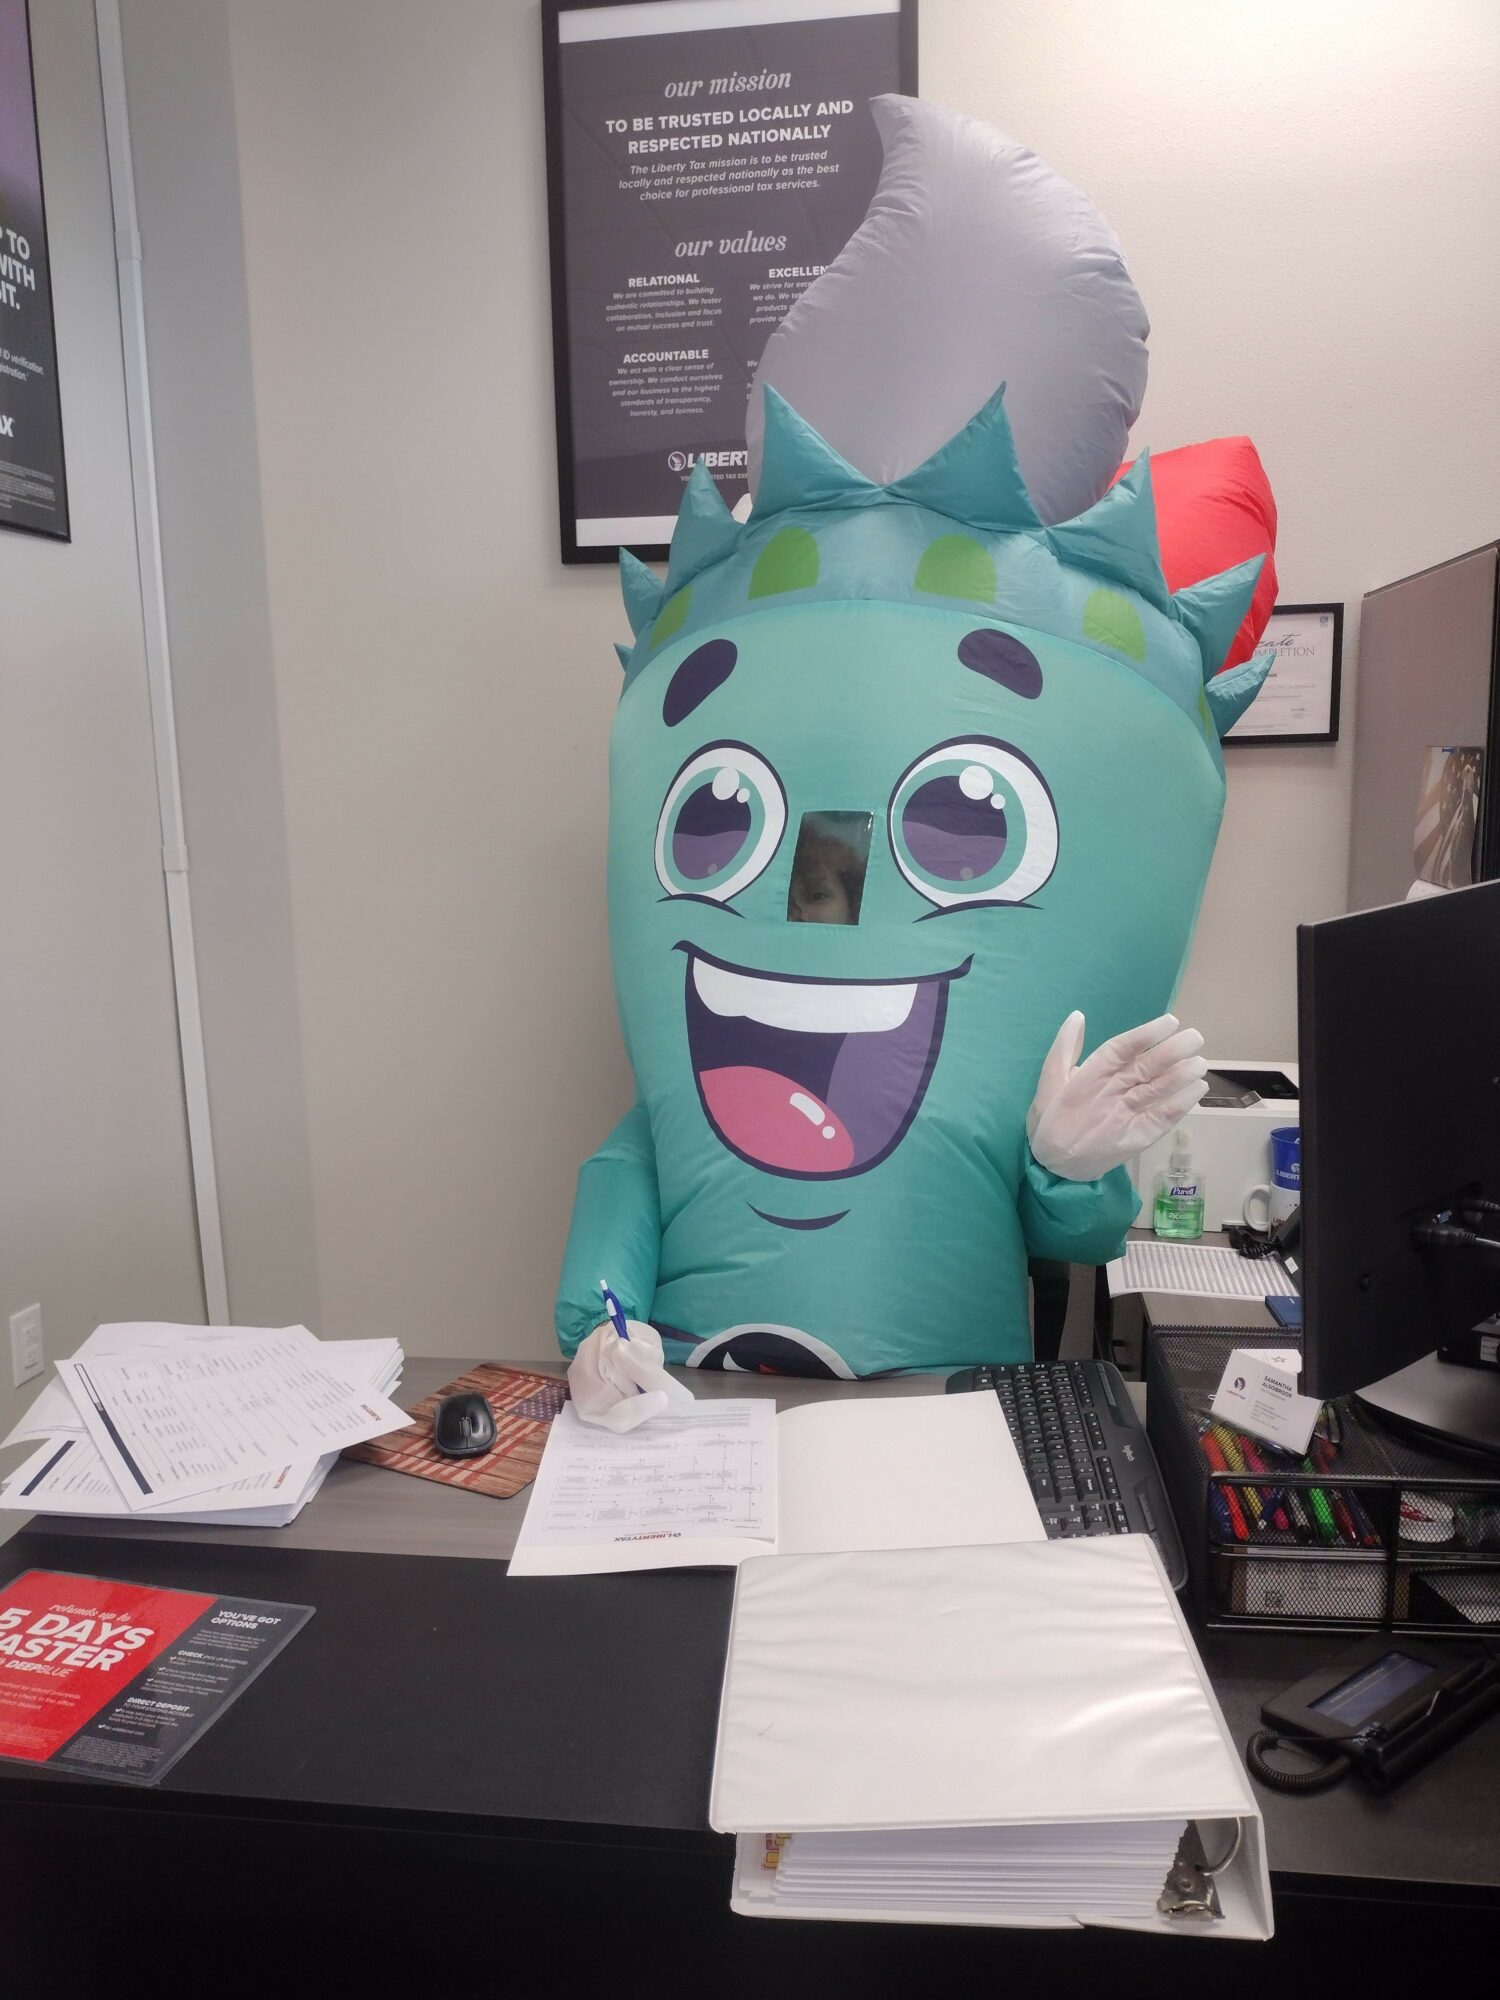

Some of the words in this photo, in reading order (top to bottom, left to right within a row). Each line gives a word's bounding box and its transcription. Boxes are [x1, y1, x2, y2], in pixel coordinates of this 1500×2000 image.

[664, 79, 704, 98] our
[708, 68, 792, 95] mission
[606, 119, 627, 133] TO
[633, 117, 653, 132] BE
[658, 110, 734, 130] TRUSTED
[739, 103, 811, 123] LOCALLY
[816, 100, 854, 115] AND
[628, 134, 723, 154] RESPECTED
[728, 124, 832, 146] NATIONALLY
[630, 165, 648, 175] The
[651, 161, 686, 175] Liberty
[689, 159, 706, 170] Tax
[709, 156, 747, 168] mission
[749, 154, 759, 165] is
[761, 154, 772, 164] to
[774, 152, 788, 163] be
[790, 150, 828, 162] trusted
[618, 178, 652, 190] locally
[654, 176, 673, 186] and
[676, 172, 725, 187] respected
[728, 167, 779, 182] nationally
[782, 167, 794, 176] as
[797, 165, 814, 175] the
[817, 163, 840, 173] best
[640, 190, 673, 201] choice
[675, 188, 690, 199] for
[692, 183, 754, 199] professional
[757, 182, 773, 192] tax
[775, 179, 820, 191] services.
[6, 228, 30, 260] TO
[674, 238, 714, 257] our
[718, 230, 787, 255] values
[628, 273, 700, 288] RELATIONAL
[762, 282, 783, 290] strive
[784, 281, 795, 289] for
[655, 311, 686, 319] inclusion
[749, 316, 777, 324] provide
[652, 322, 680, 330] success
[623, 349, 709, 364] ACCOUNTABLE
[694, 384, 720, 393] highest
[1264, 1375, 1292, 1391] SAMANTHA
[49, 1604, 98, 1617] refunds
[218, 1610, 258, 1622] YOU'VE
[259, 1616, 281, 1625] GOT
[0, 1607, 32, 1630] 5
[25, 1613, 155, 1650] DAYS
[211, 1617, 258, 1629] OPTIONS
[178, 1650, 204, 1659] CHECK
[127, 1697, 155, 1707] DIRECT
[155, 1701, 190, 1712] DEPOSIT
